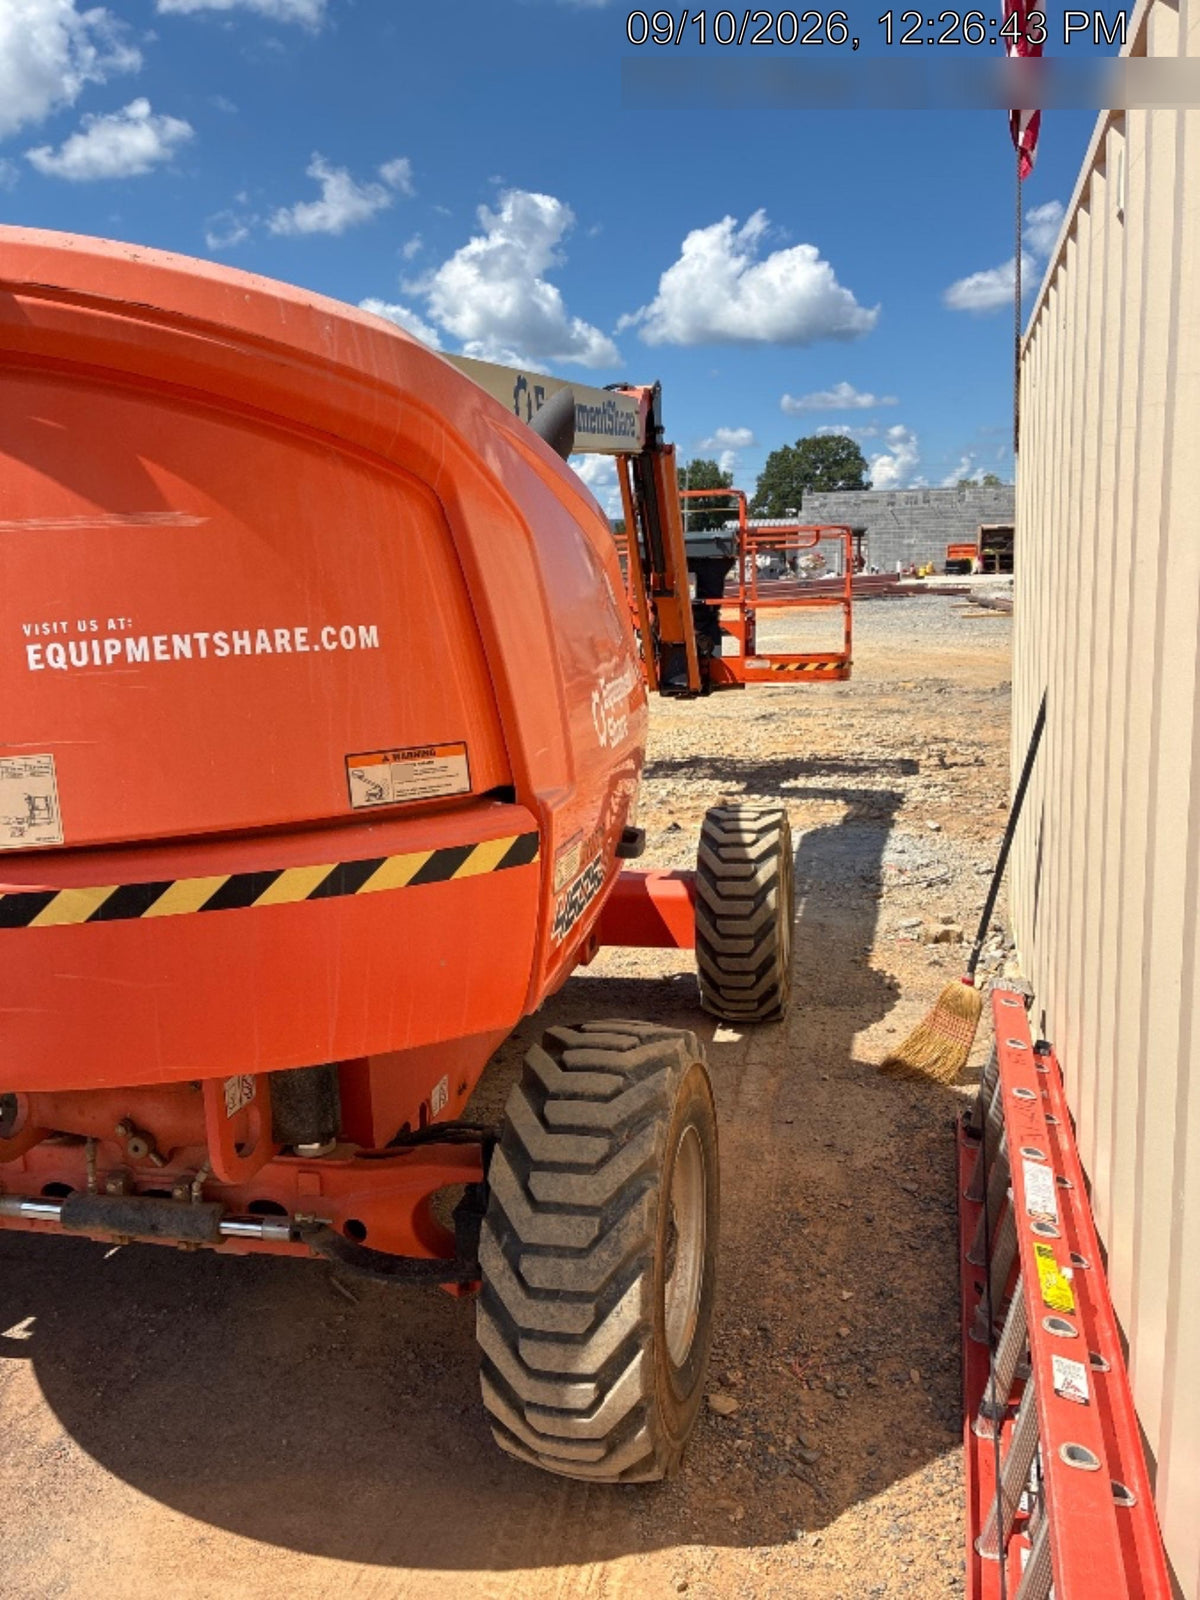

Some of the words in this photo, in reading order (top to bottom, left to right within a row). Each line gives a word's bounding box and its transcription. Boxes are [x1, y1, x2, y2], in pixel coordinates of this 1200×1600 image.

[22, 622, 68, 637] VISIT
[77, 619, 98, 632] US
[107, 617, 132, 631] AT:
[26, 625, 379, 671] EQUIPMENTSHARE.COM
